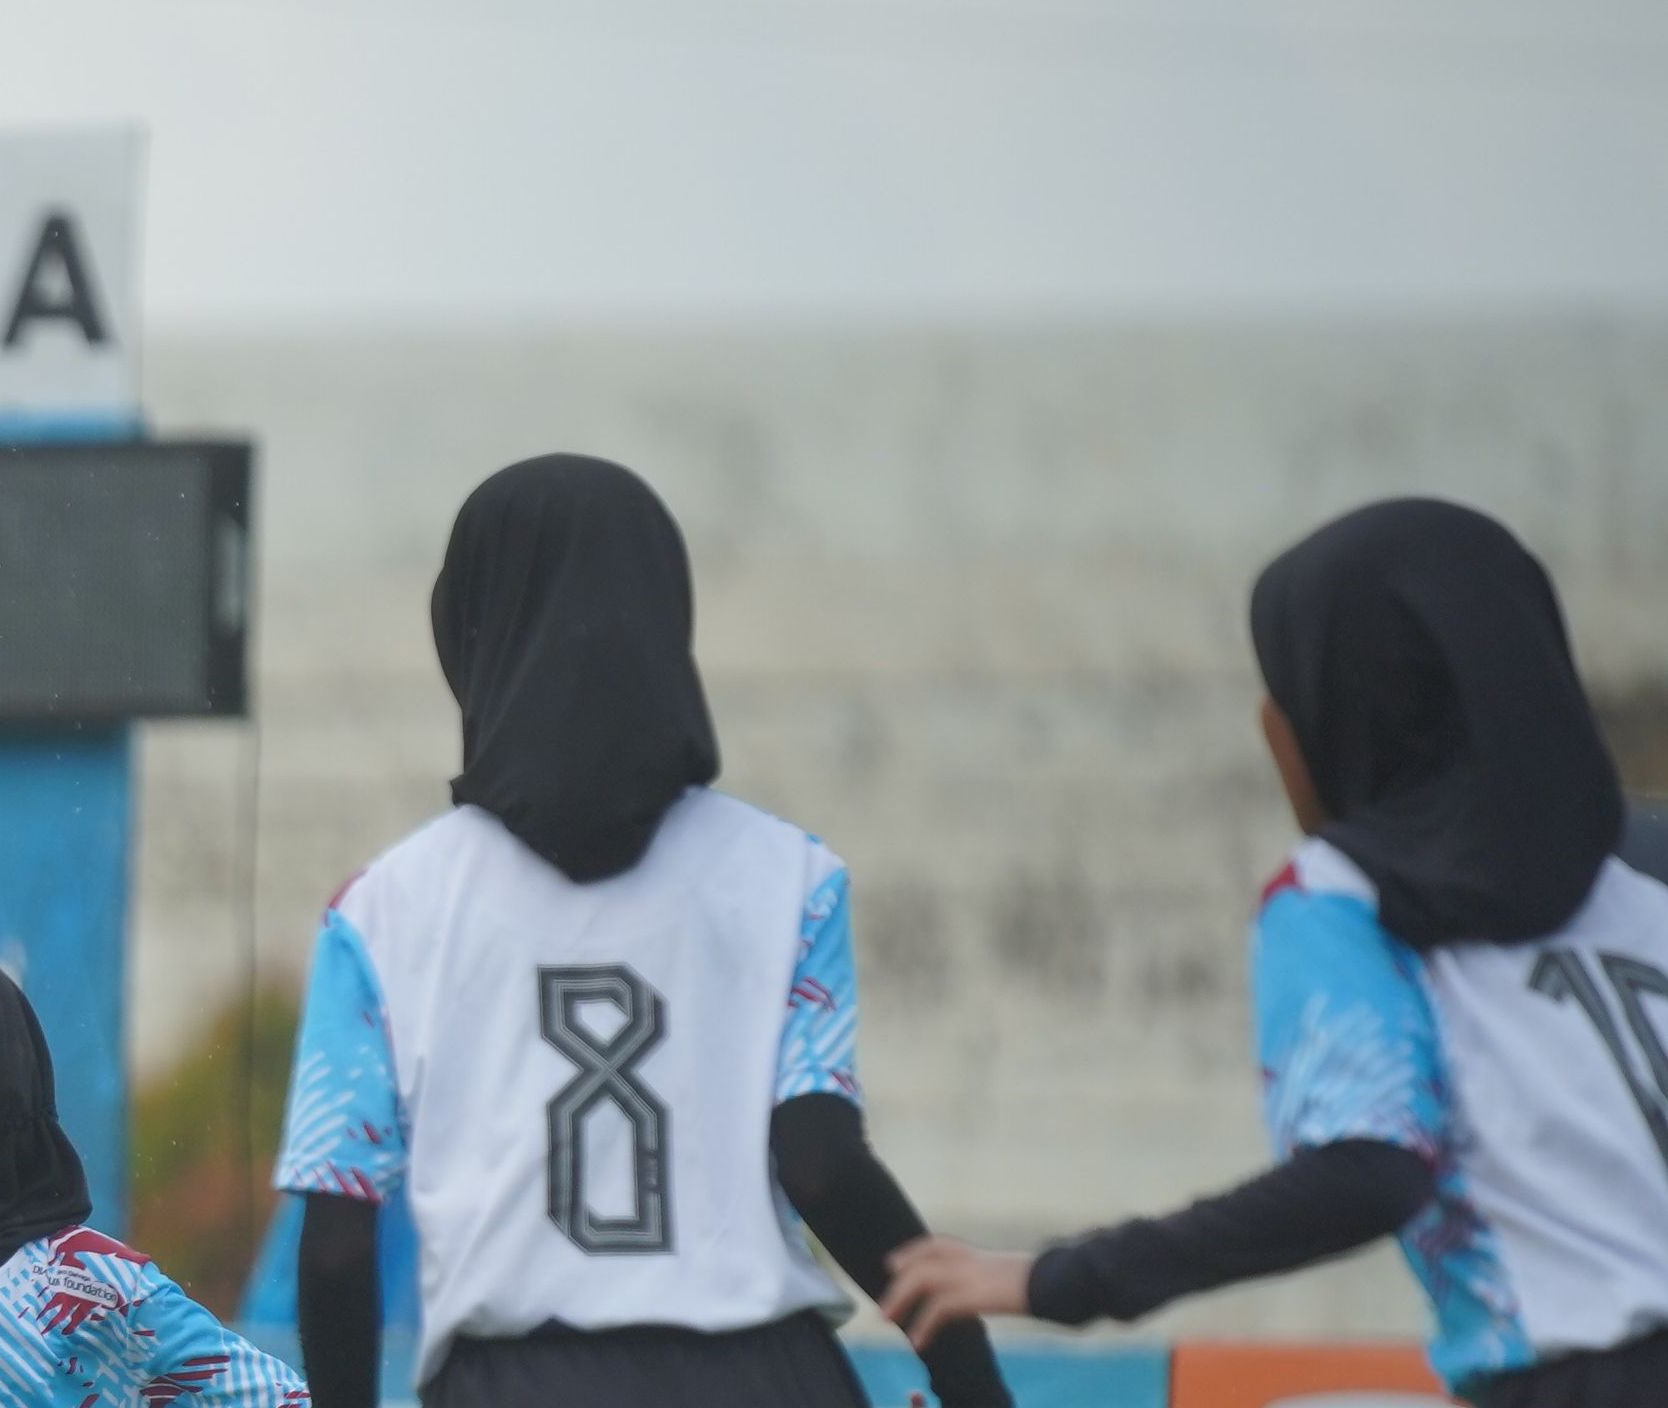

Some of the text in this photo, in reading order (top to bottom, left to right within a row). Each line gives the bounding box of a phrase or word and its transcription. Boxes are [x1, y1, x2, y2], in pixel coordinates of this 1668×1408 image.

[1, 209, 111, 350] A
[536, 963, 677, 1256] 8
[63, 1276, 118, 1302] foundation
